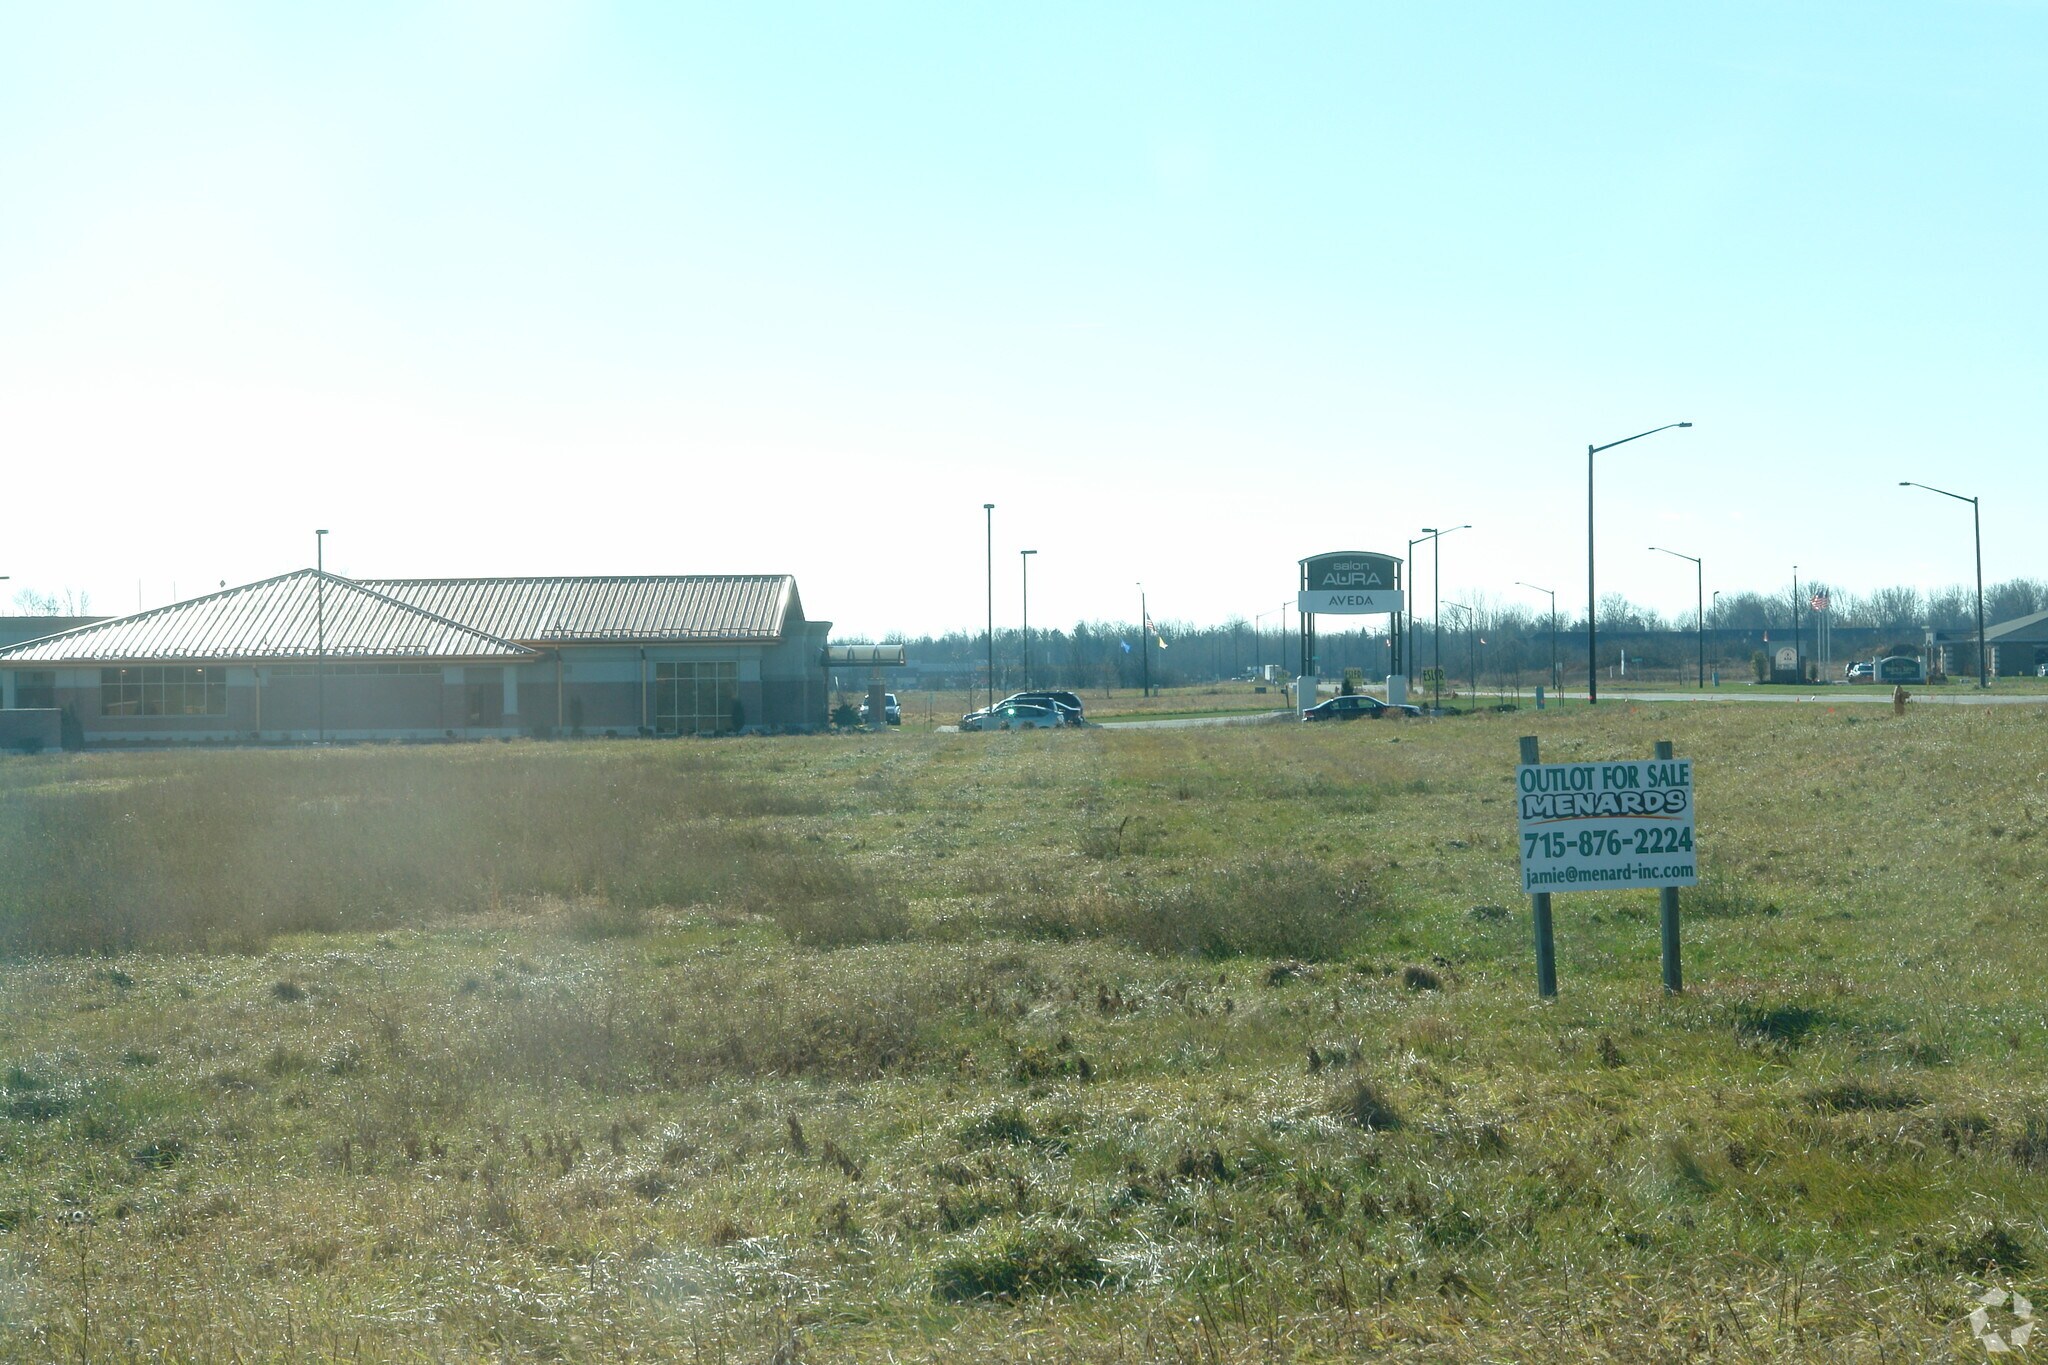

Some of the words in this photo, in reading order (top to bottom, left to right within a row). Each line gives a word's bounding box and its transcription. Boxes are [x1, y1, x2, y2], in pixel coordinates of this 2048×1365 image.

[1322, 573, 1382, 585] AURA
[1333, 560, 1370, 571] salon
[1328, 595, 1374, 606] AVEDA
[1520, 767, 1595, 793] OUTLOT
[1602, 765, 1640, 790] FOR
[1647, 763, 1689, 788] SALE
[1522, 789, 1687, 820] MENARDS
[1524, 826, 1693, 859] 715-876-2224
[1526, 862, 1694, 890] jamie@menard-inc.com
